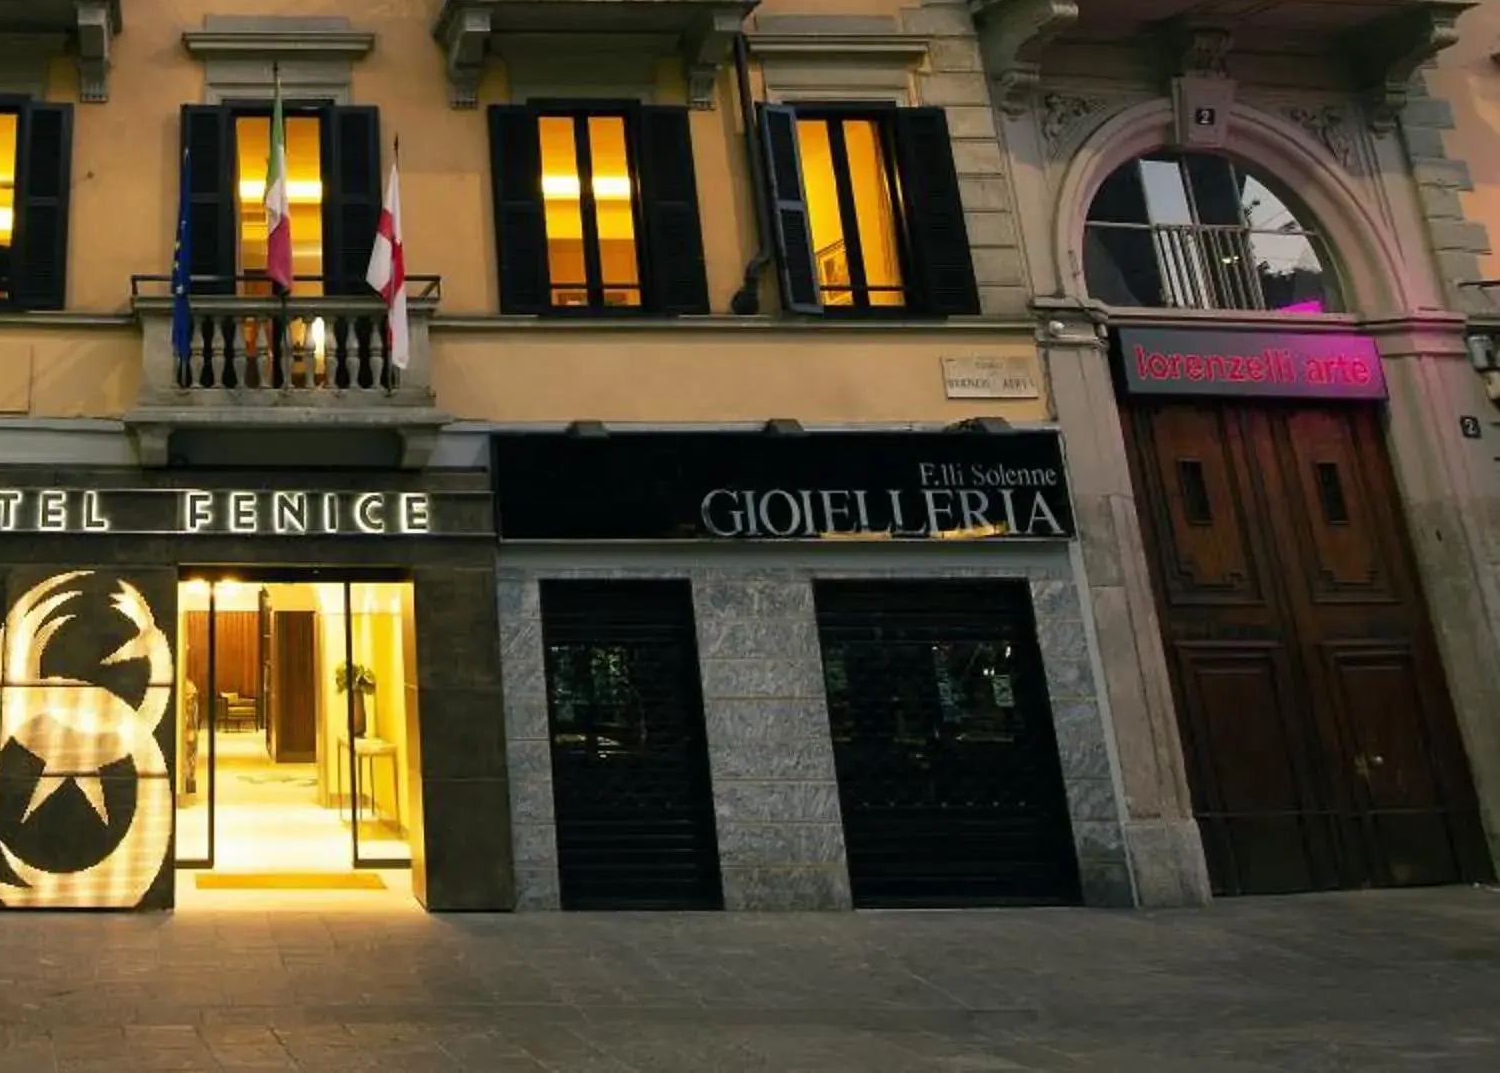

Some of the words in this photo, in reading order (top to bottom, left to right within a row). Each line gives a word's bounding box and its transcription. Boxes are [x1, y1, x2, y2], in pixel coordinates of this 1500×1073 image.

[1200, 109, 1211, 124] 2
[1135, 344, 1297, 384] lorenzelli
[1305, 355, 1370, 385] arte
[971, 463, 1058, 486] Solenne
[184, 491, 430, 535] FENICE
[700, 488, 1065, 537] GIOIELLERIA
